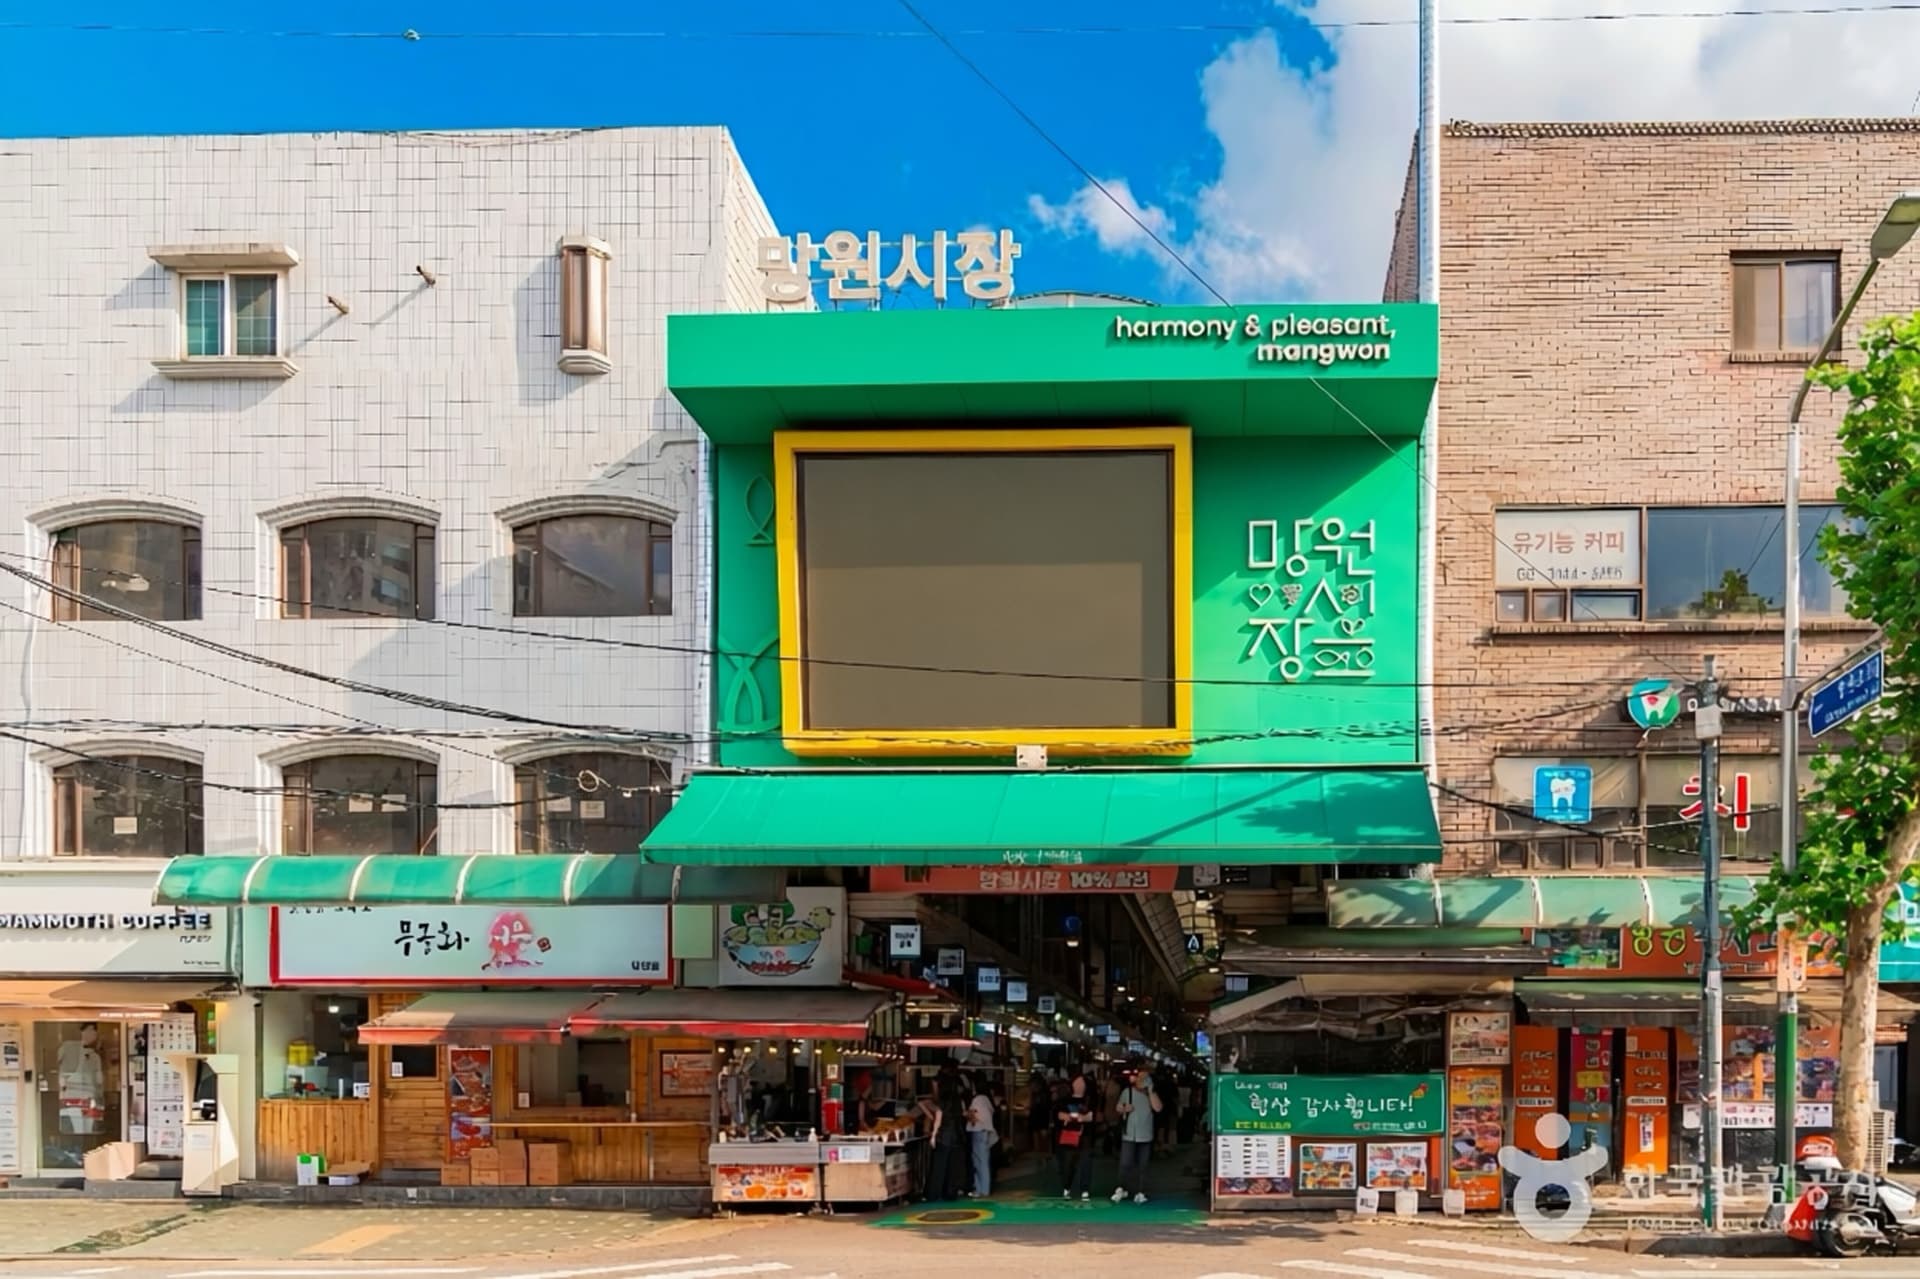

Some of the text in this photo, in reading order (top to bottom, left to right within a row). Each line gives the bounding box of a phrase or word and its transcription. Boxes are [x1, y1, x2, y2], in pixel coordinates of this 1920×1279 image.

[757, 229, 1022, 302] 망원시장
[1115, 313, 1397, 341] harmony & pleasant,
[1257, 342, 1391, 366] mangwon
[1584, 530, 1626, 554] 커피
[0, 911, 212, 931] MAMMOTH COFFEE
